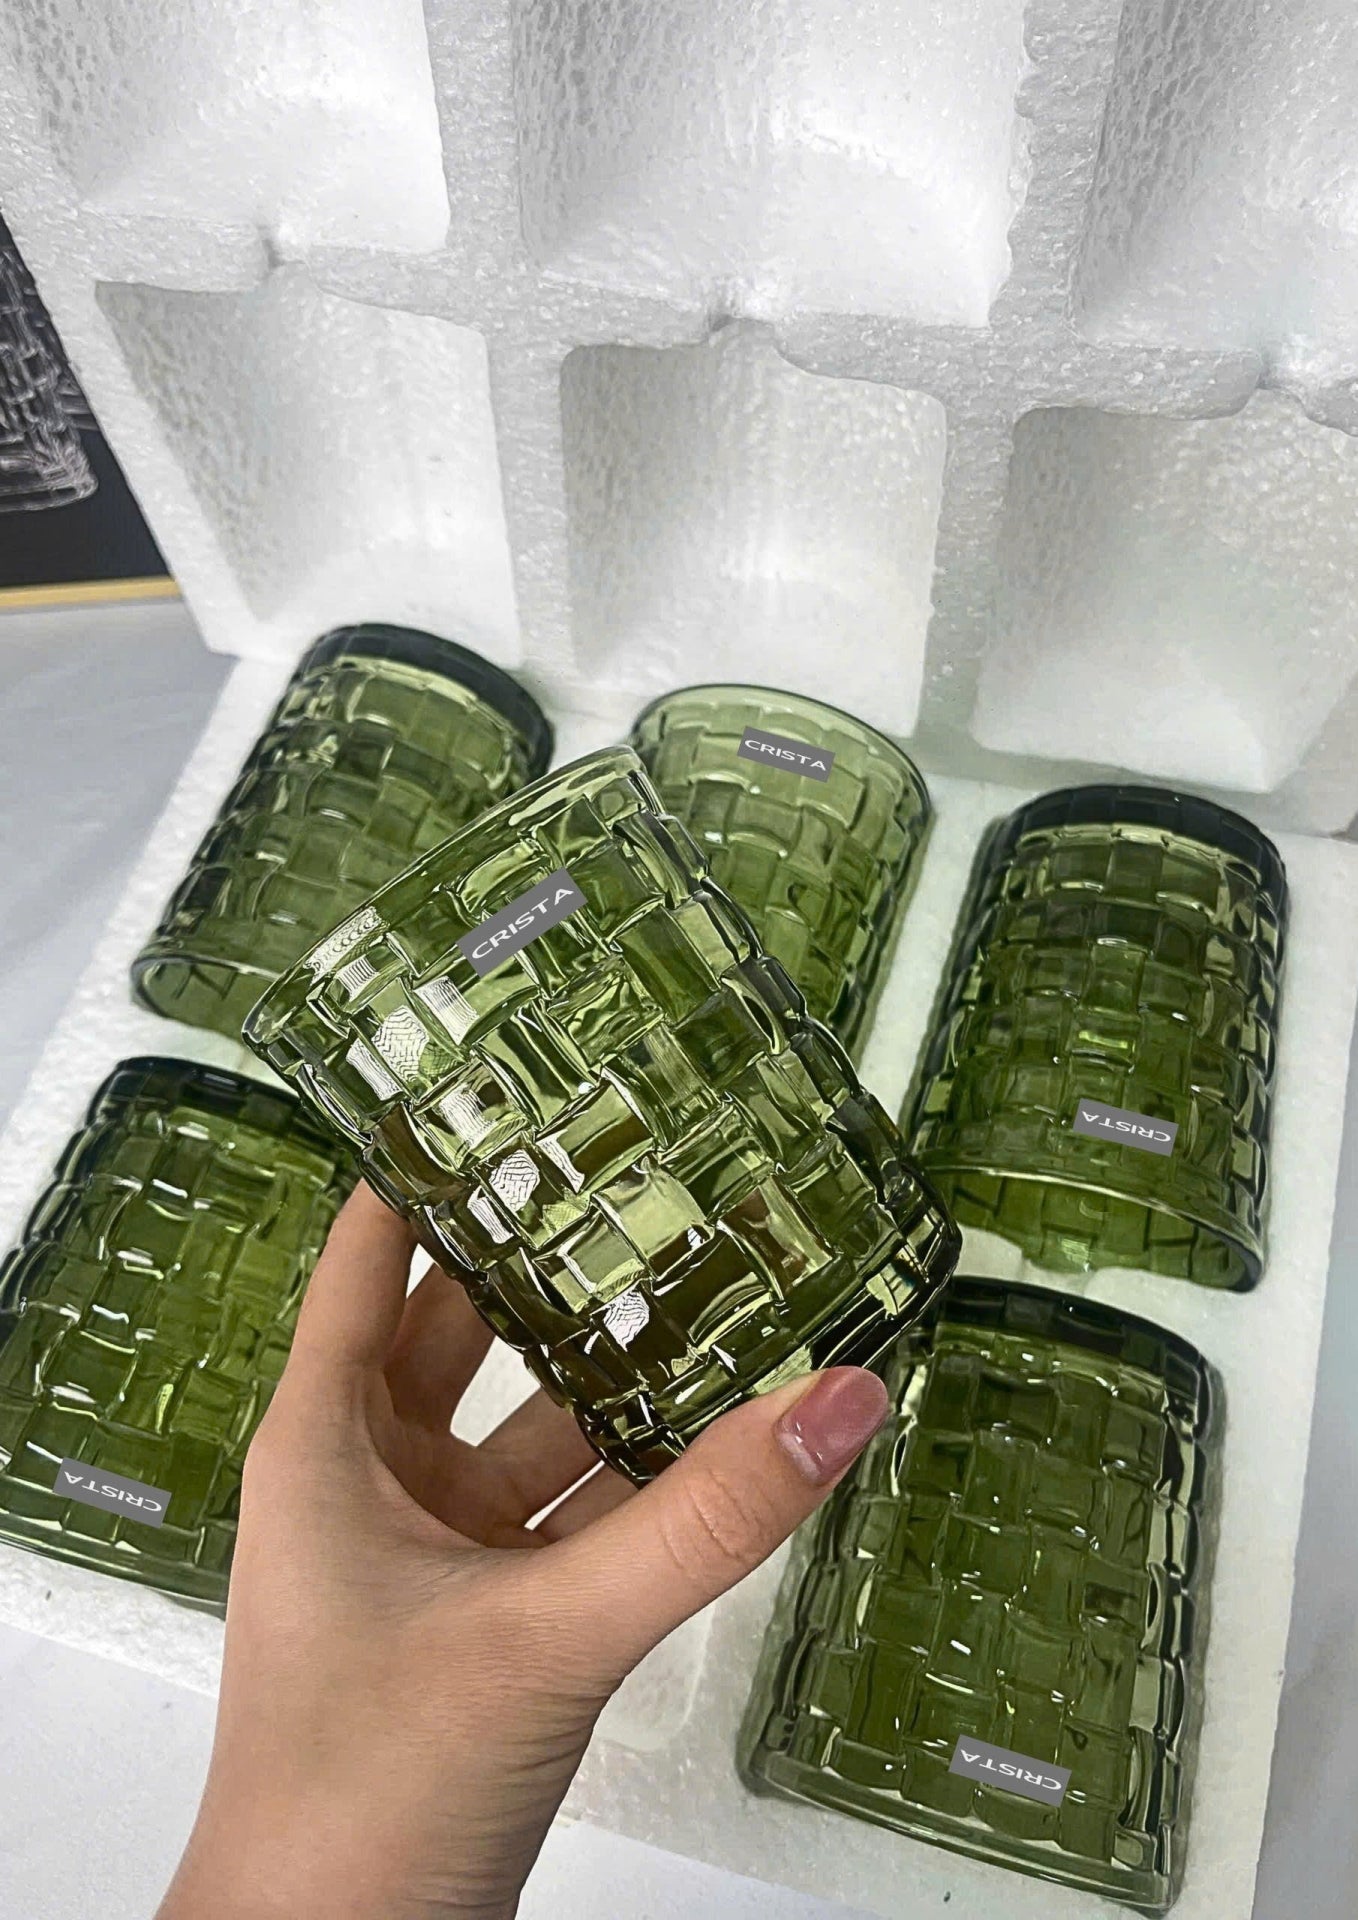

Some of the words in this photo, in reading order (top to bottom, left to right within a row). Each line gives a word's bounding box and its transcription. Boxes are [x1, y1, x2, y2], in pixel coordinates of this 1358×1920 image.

[744, 739, 827, 772] CRISTA
[471, 888, 575, 959] CRISTA
[1081, 1110, 1171, 1142] CRISTA
[63, 1471, 162, 1512] CRISTA
[960, 1748, 1062, 1790] CRISTA
